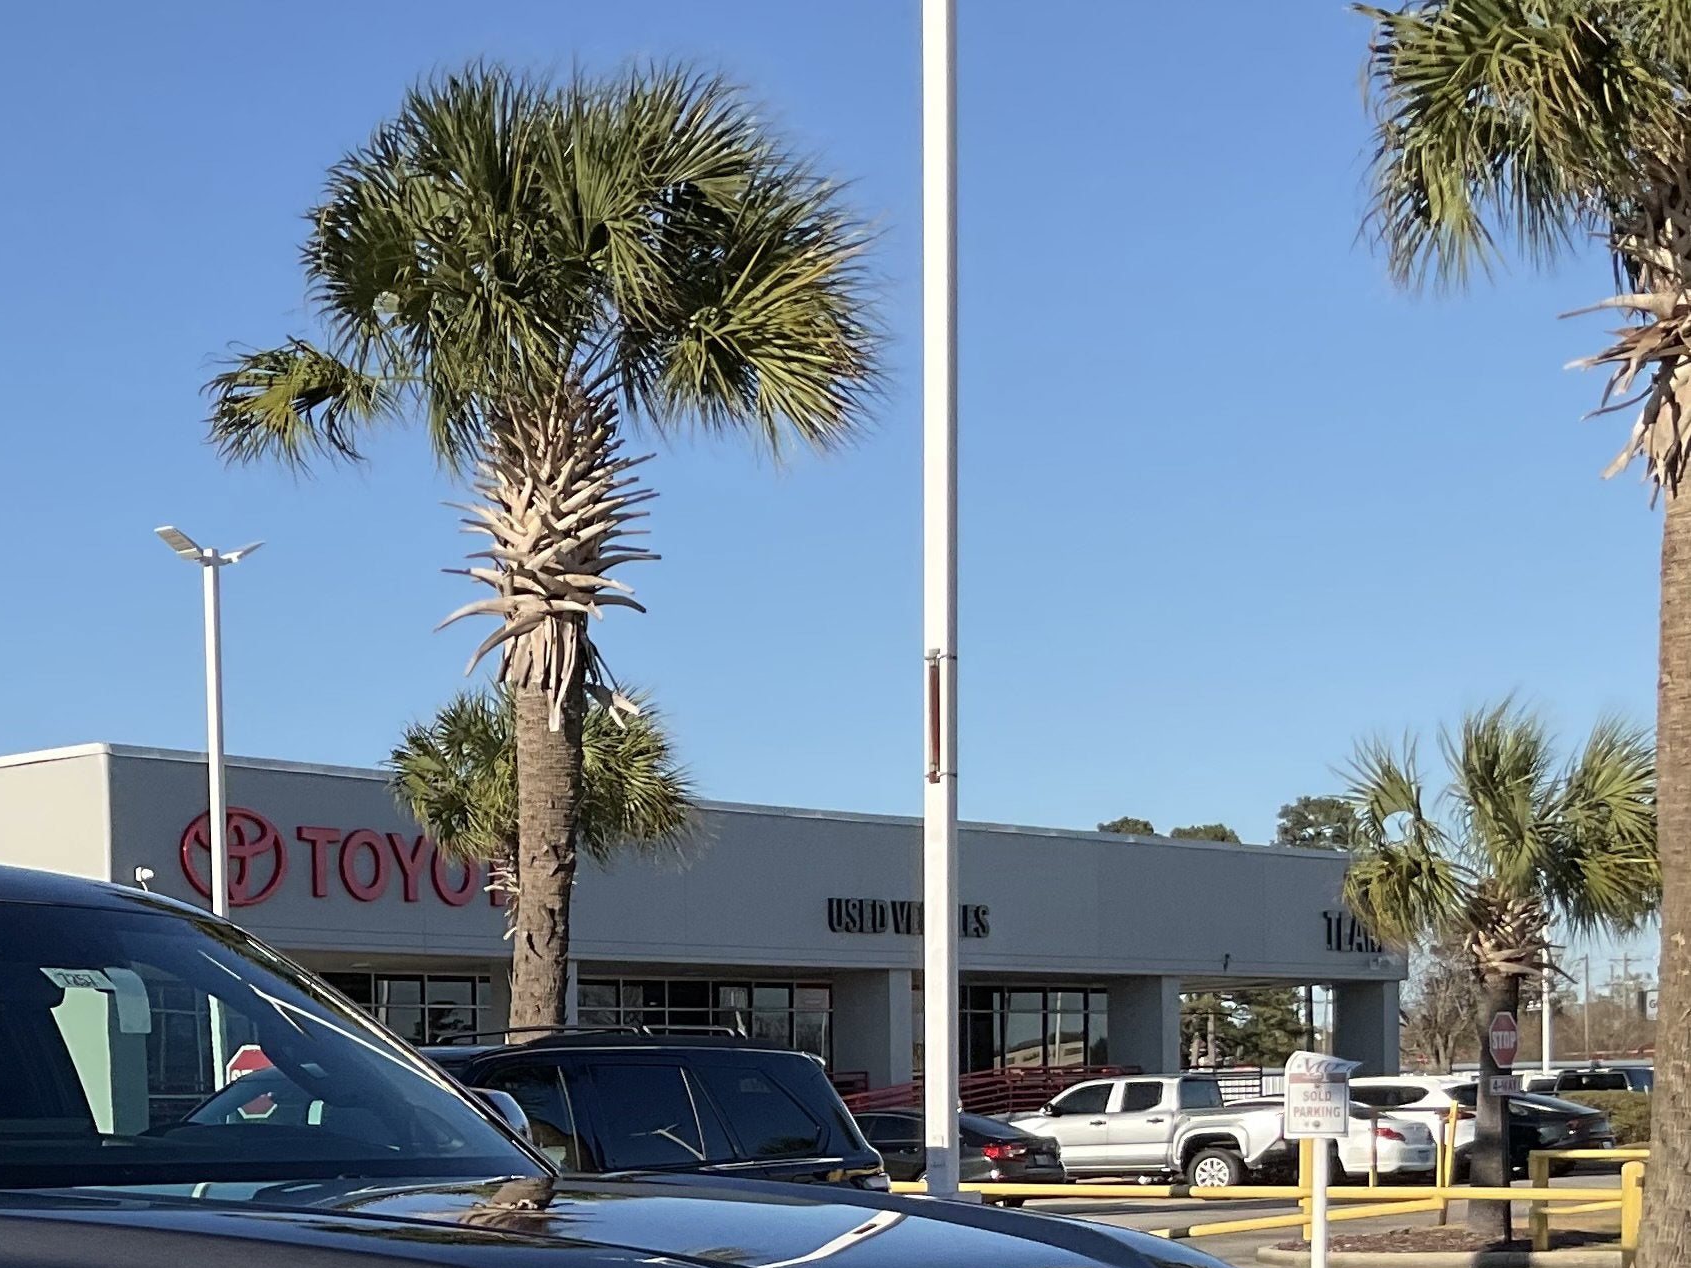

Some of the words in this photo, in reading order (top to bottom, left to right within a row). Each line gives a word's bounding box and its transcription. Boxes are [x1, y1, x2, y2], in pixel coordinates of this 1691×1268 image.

[296, 826, 517, 907] TOYO
[827, 897, 888, 934] USED
[891, 900, 991, 938] VEES
[1492, 1030, 1516, 1050] STOP
[1302, 1090, 1332, 1102] SOLD
[1292, 1105, 1341, 1118] PARKING
